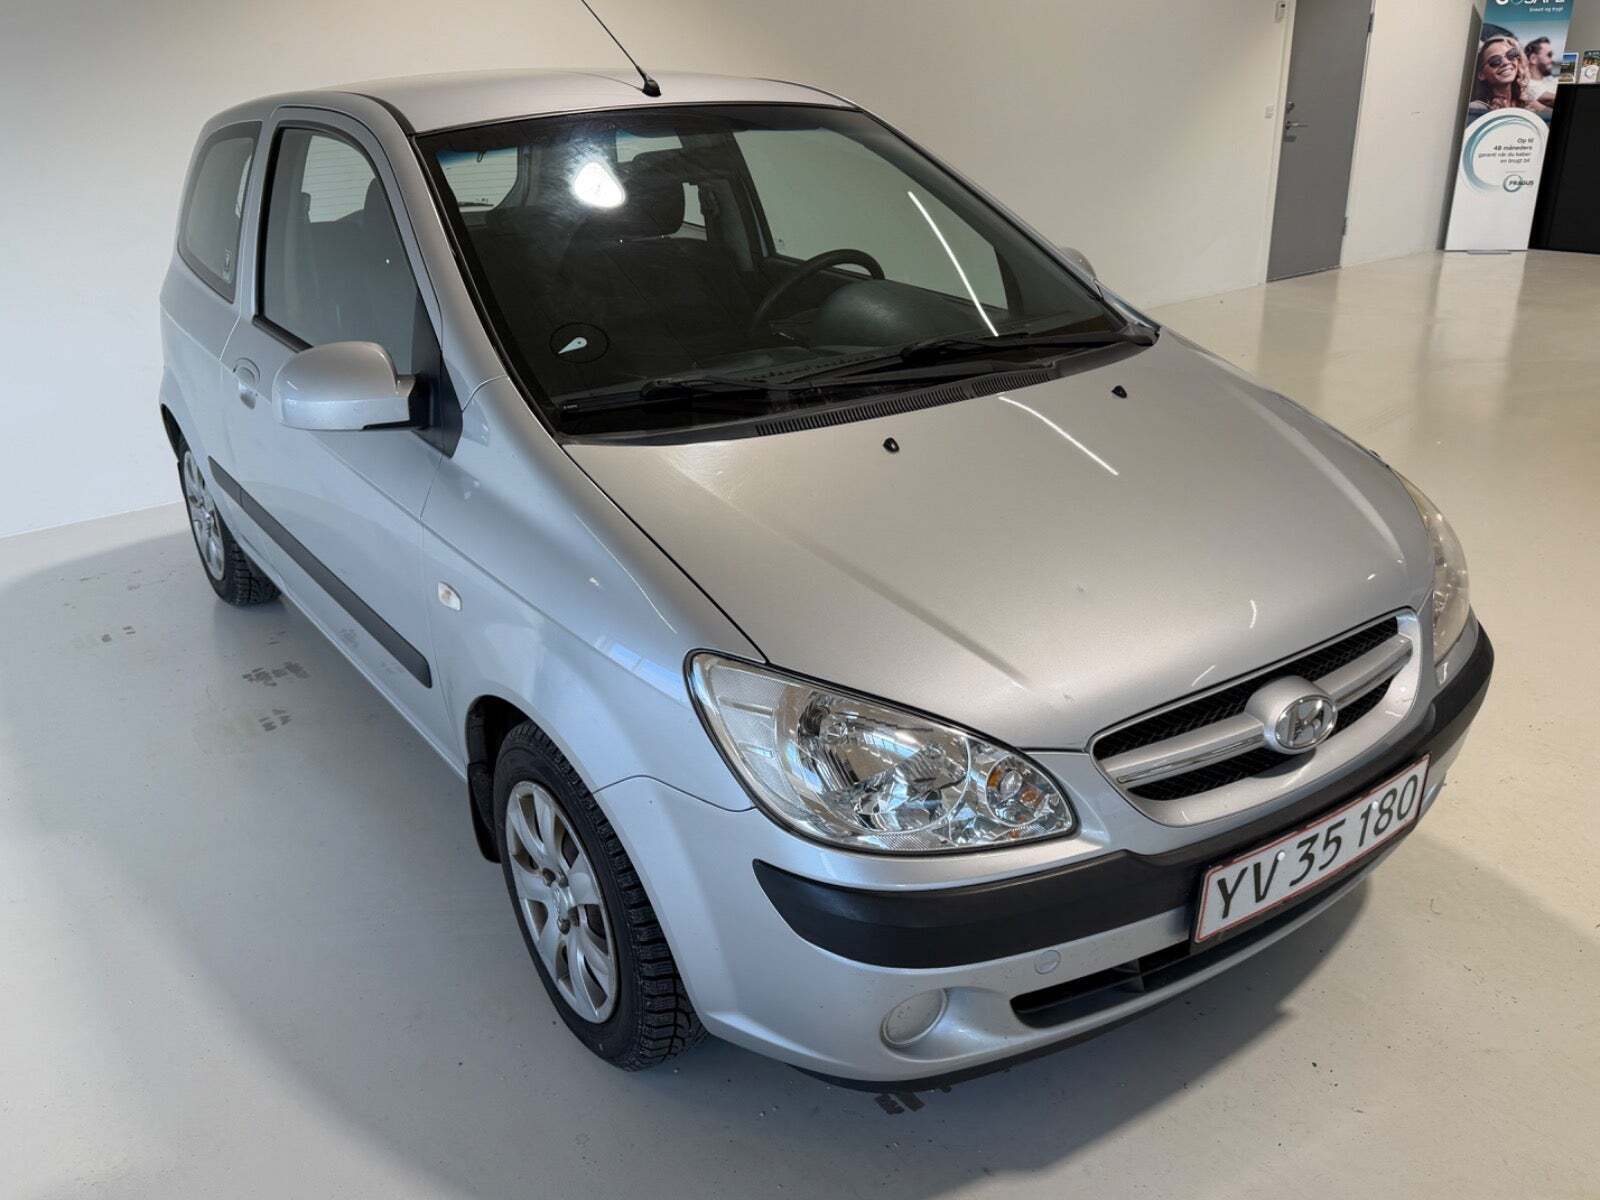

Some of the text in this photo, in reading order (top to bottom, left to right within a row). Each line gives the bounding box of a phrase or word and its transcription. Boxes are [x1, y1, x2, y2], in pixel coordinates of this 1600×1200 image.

[1217, 774, 1418, 919] YV 35 180
